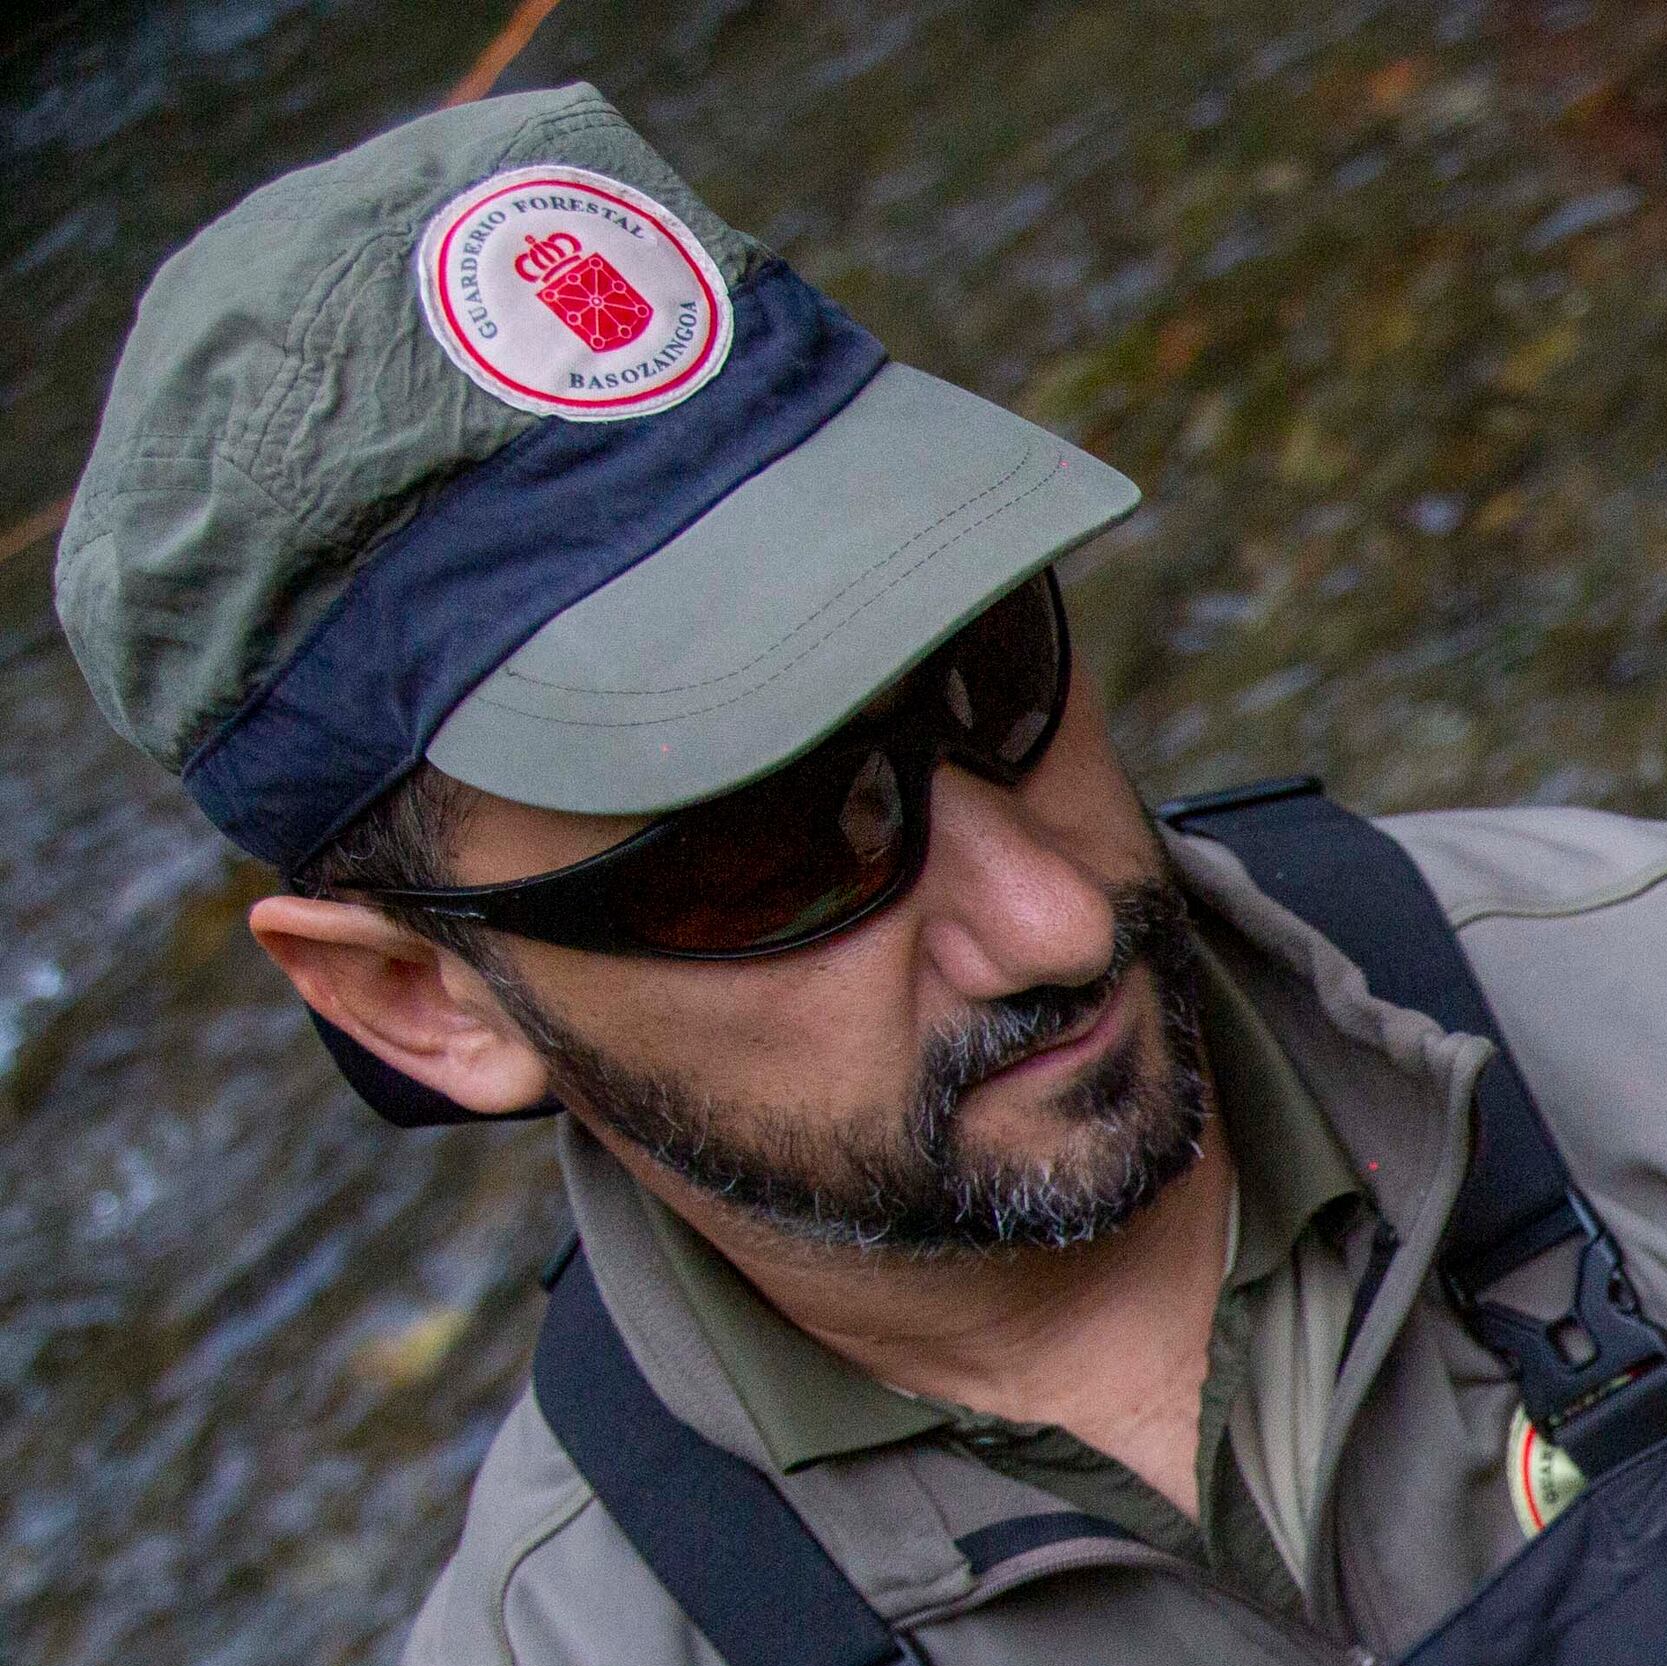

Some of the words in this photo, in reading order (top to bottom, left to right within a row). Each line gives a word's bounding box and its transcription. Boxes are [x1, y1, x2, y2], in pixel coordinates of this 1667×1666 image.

[460, 210, 506, 339] GUARDERIO
[512, 196, 645, 240] FORESTAL
[569, 300, 698, 390] BASOZAINGOA
